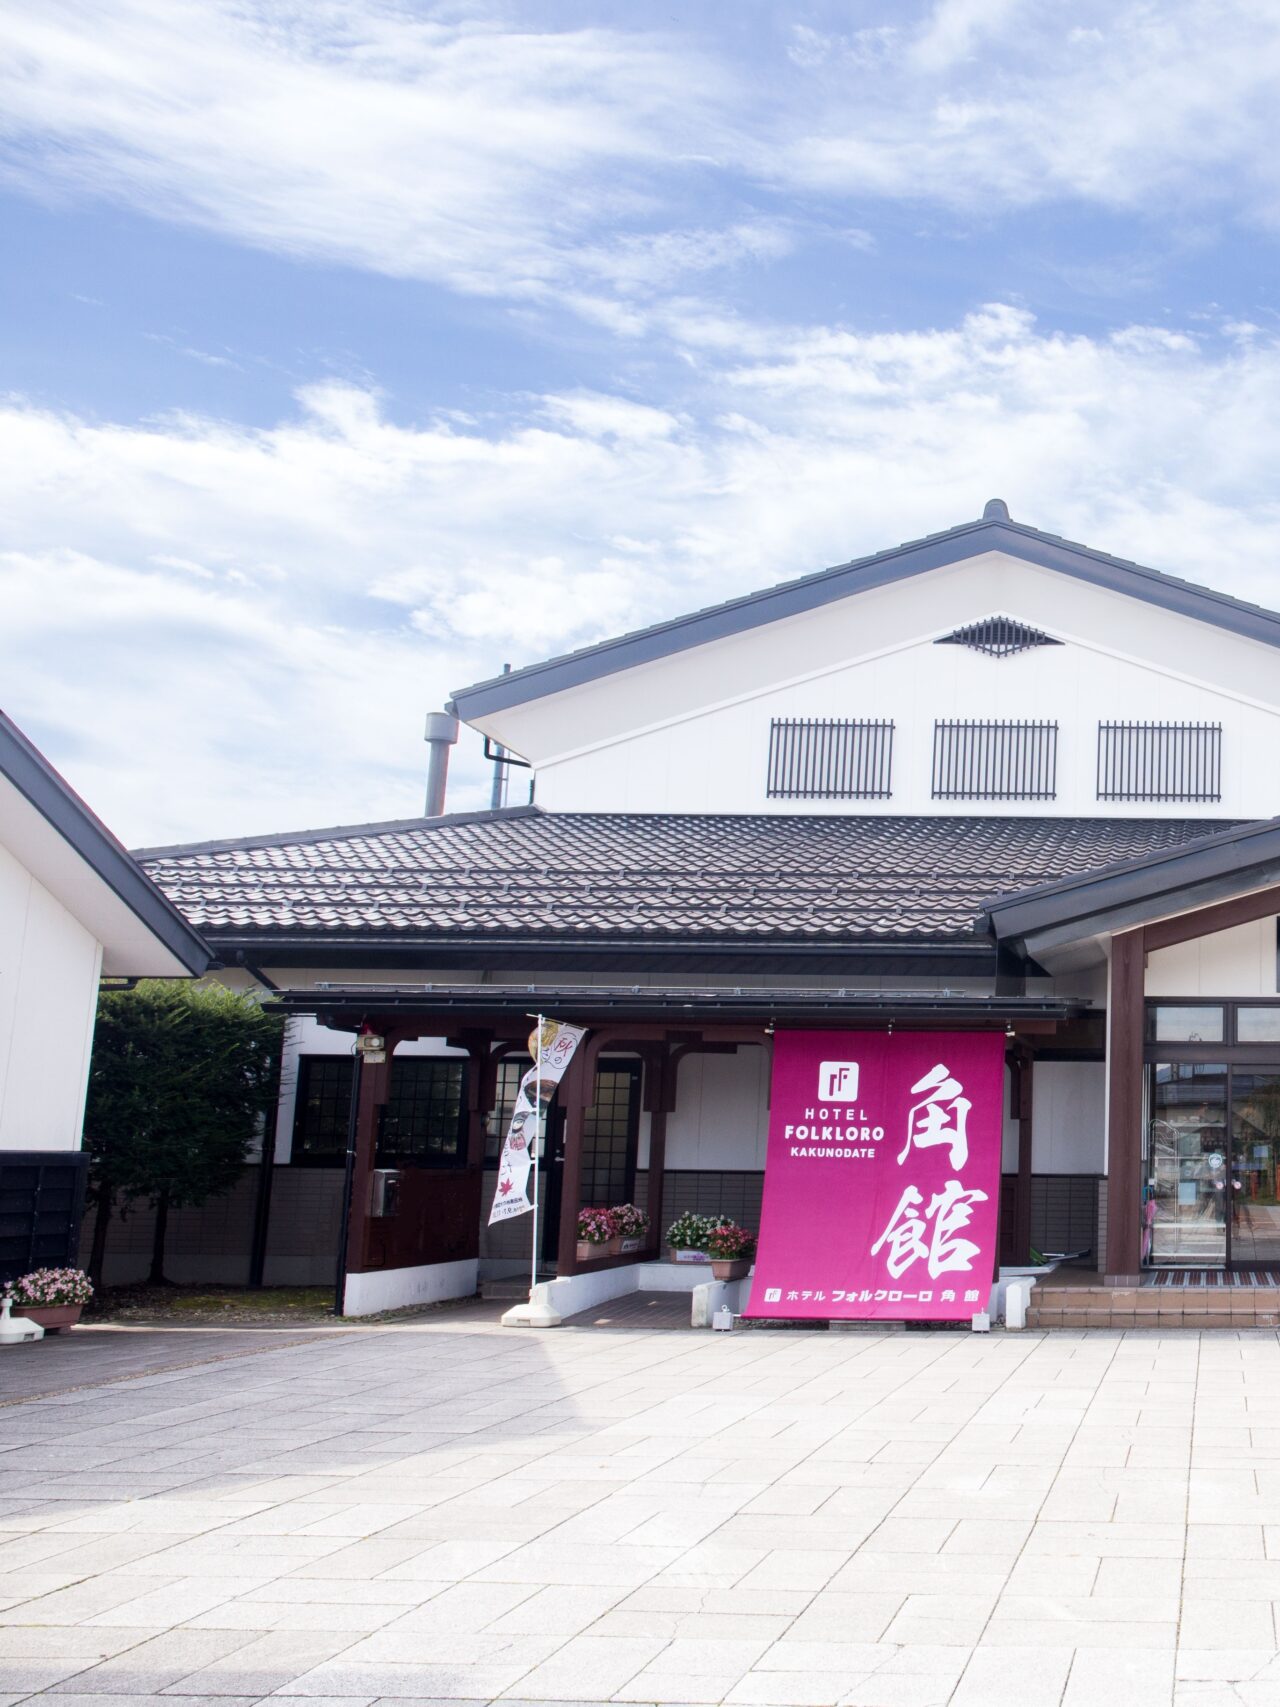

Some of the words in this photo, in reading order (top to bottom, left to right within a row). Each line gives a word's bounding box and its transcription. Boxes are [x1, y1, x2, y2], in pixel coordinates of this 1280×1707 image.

[804, 1108, 868, 1121] HOTEL
[784, 1125, 885, 1141] FOLKLORO
[790, 1147, 875, 1158] KAKUNODATE
[871, 1063, 988, 1280] 角館
[786, 1290, 826, 1301] ホテル
[831, 1290, 933, 1302] フォルクローロ
[940, 1289, 980, 1302] 角館
